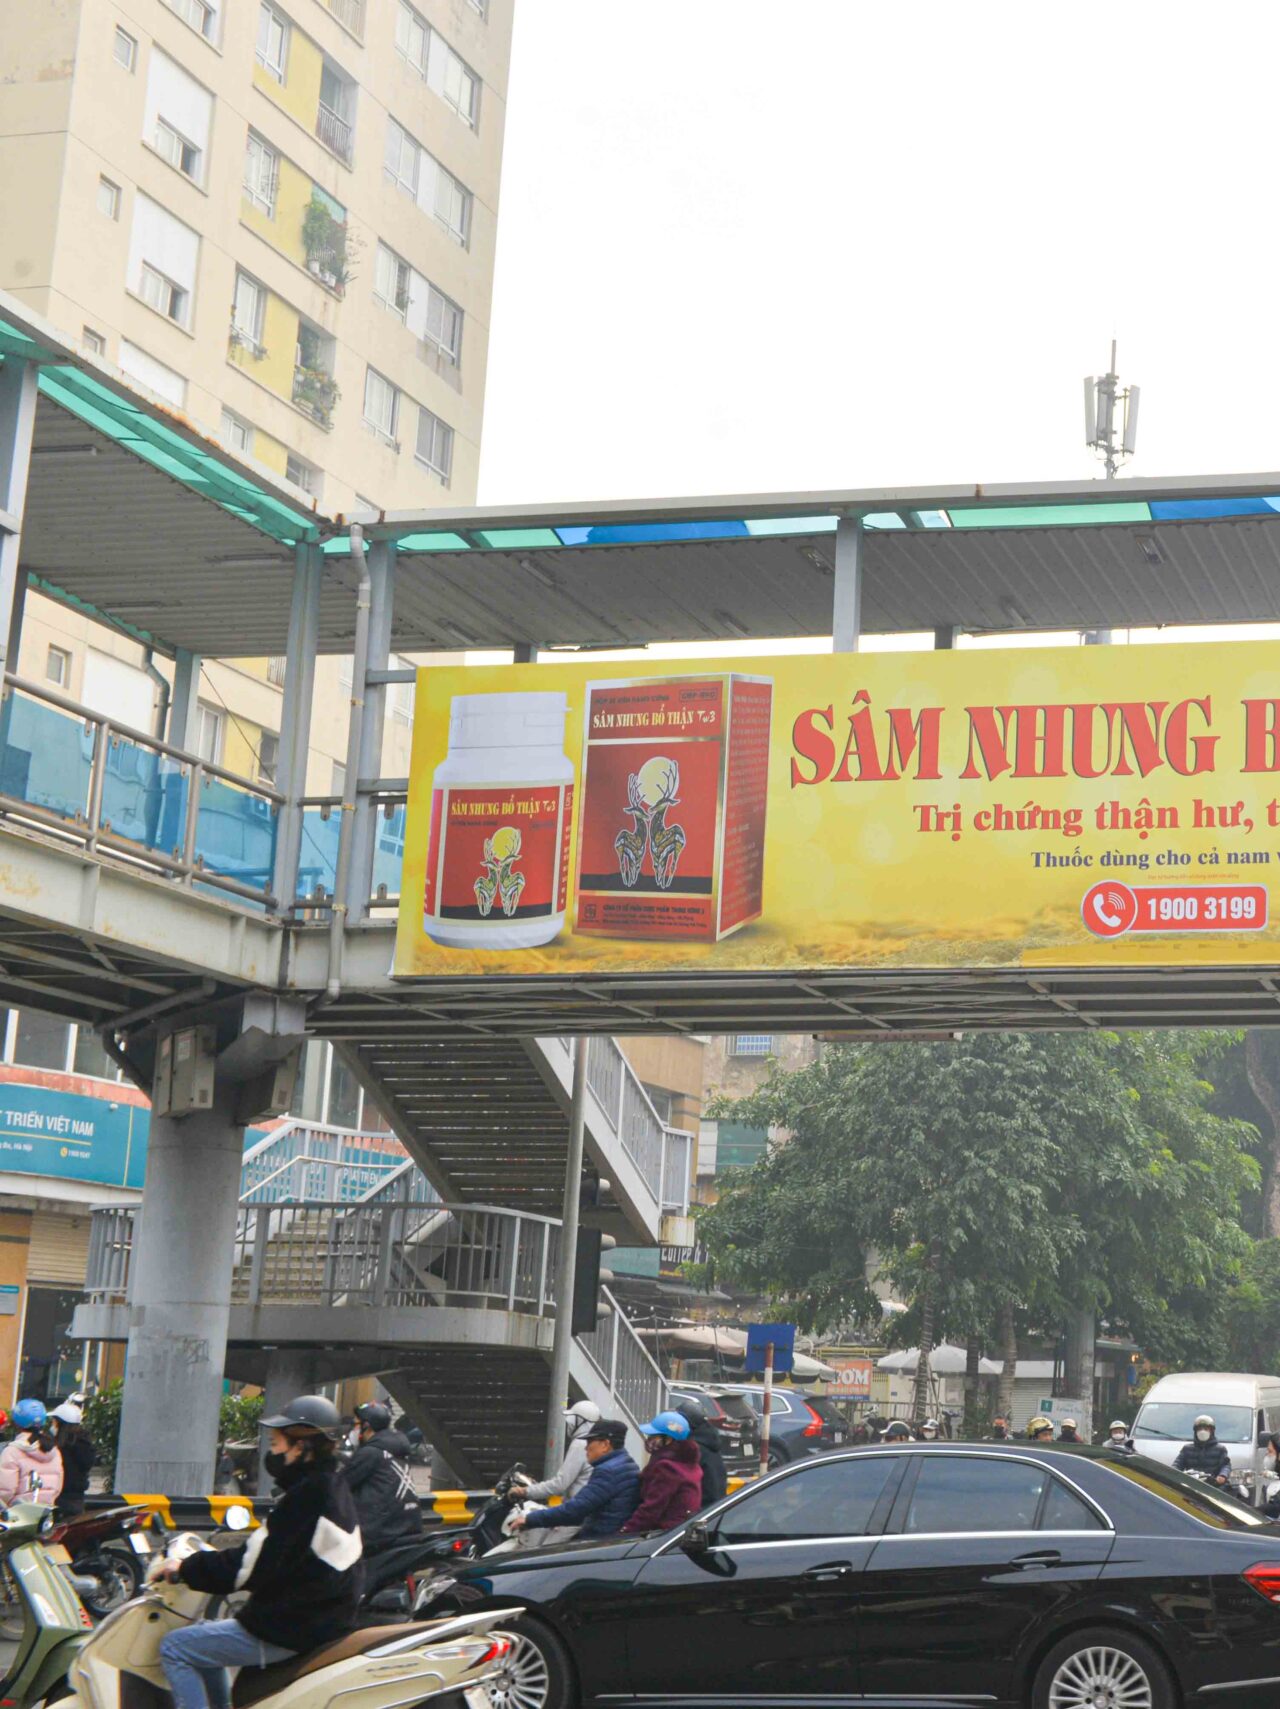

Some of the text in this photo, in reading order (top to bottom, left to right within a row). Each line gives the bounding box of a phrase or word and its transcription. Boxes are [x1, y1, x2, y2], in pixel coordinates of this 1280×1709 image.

[593, 710, 614, 728] SÂM
[616, 712, 649, 728] NHUNG
[651, 704, 665, 726] BỔ
[668, 707, 694, 730] THẬN
[791, 689, 945, 788] SÂM
[958, 695, 1221, 782] NHUNG
[469, 801, 500, 816] NHUNG
[913, 802, 963, 841] Trị
[973, 801, 1084, 837] chứng
[1095, 798, 1179, 839] thận
[1191, 798, 1254, 834] hư,
[1031, 846, 1093, 868] Thuốc
[1100, 850, 1150, 870] dùng
[1156, 850, 1191, 866] cho
[1199, 846, 1219, 865] cả
[1227, 852, 1270, 865] nam
[1148, 896, 1256, 921] 1900 3199
[5, 1110, 94, 1136] TRIỂN VIỆT NAM
